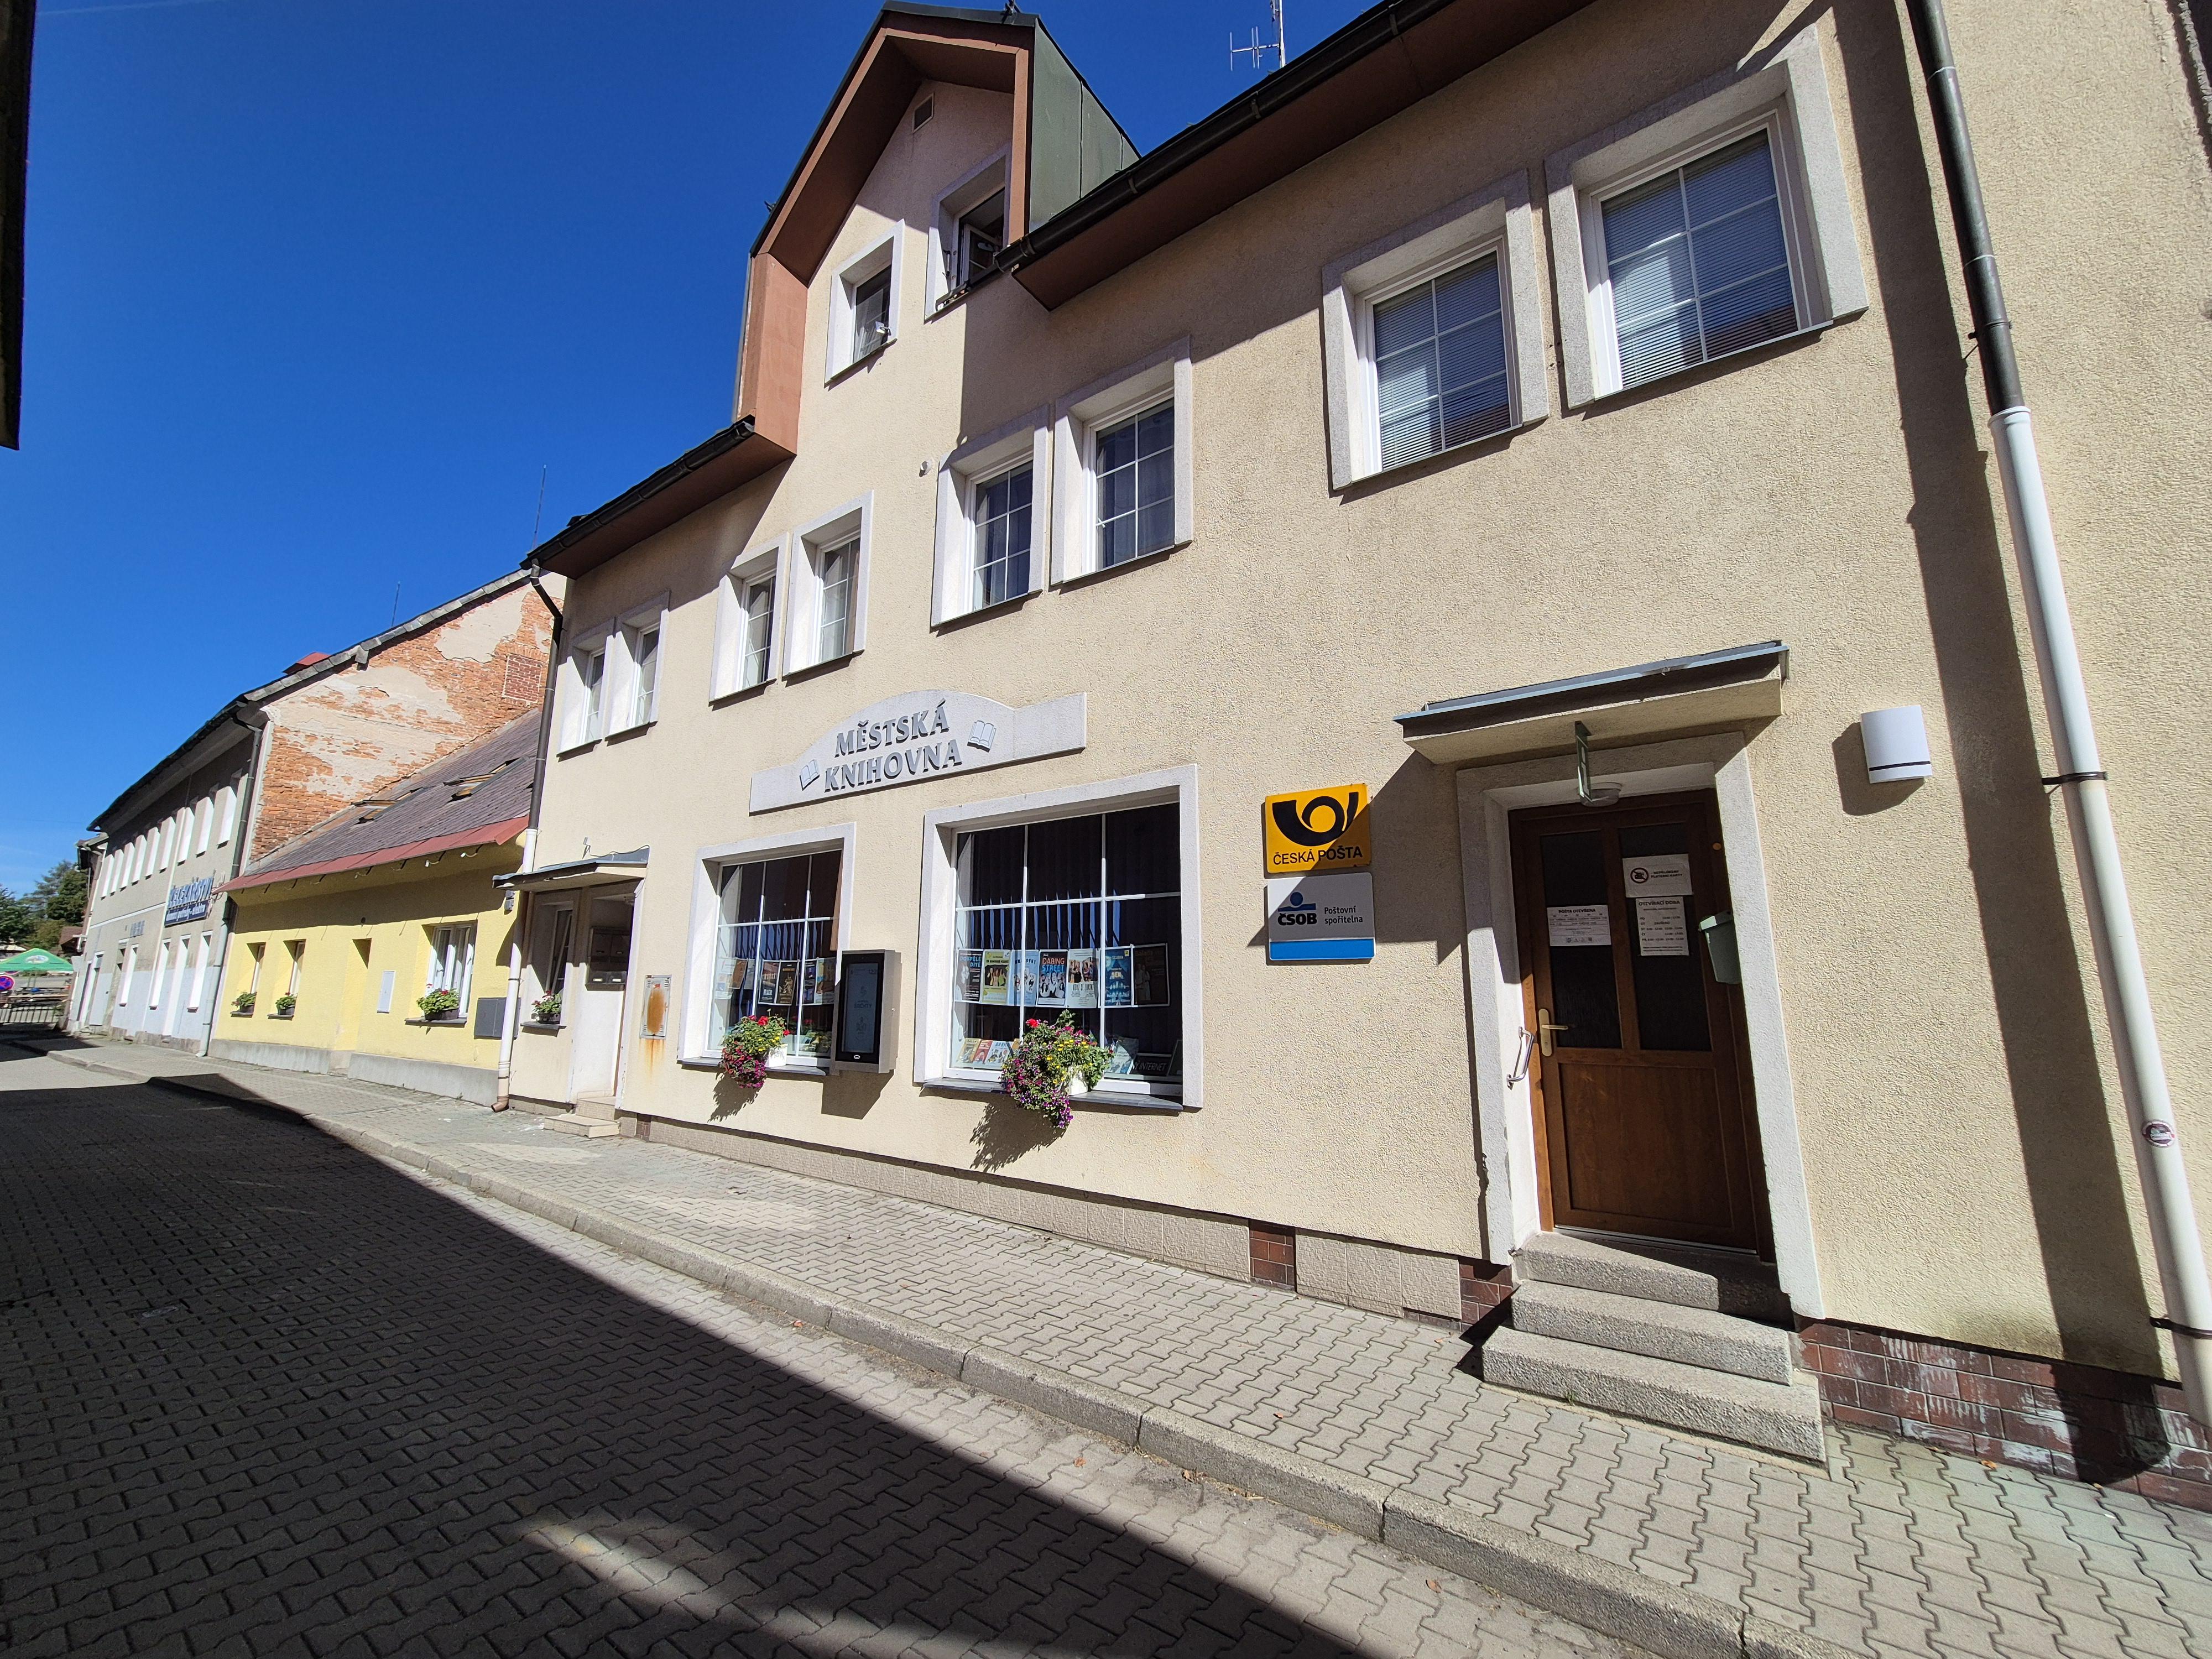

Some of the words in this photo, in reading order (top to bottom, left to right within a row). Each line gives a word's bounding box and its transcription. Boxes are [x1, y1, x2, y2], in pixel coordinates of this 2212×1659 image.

[835, 698, 950, 758] MĚSTSKÁ
[824, 739, 962, 792] KNIHOVNA
[1274, 849, 1315, 865] ČESKÁ
[1318, 846, 1363, 862] POŠTA
[1324, 906, 1357, 914] Poštovní
[1277, 913, 1317, 926] ČSOB
[1324, 915, 1363, 924] spořitelna
[1139, 1062, 1167, 1071] INTERNET
